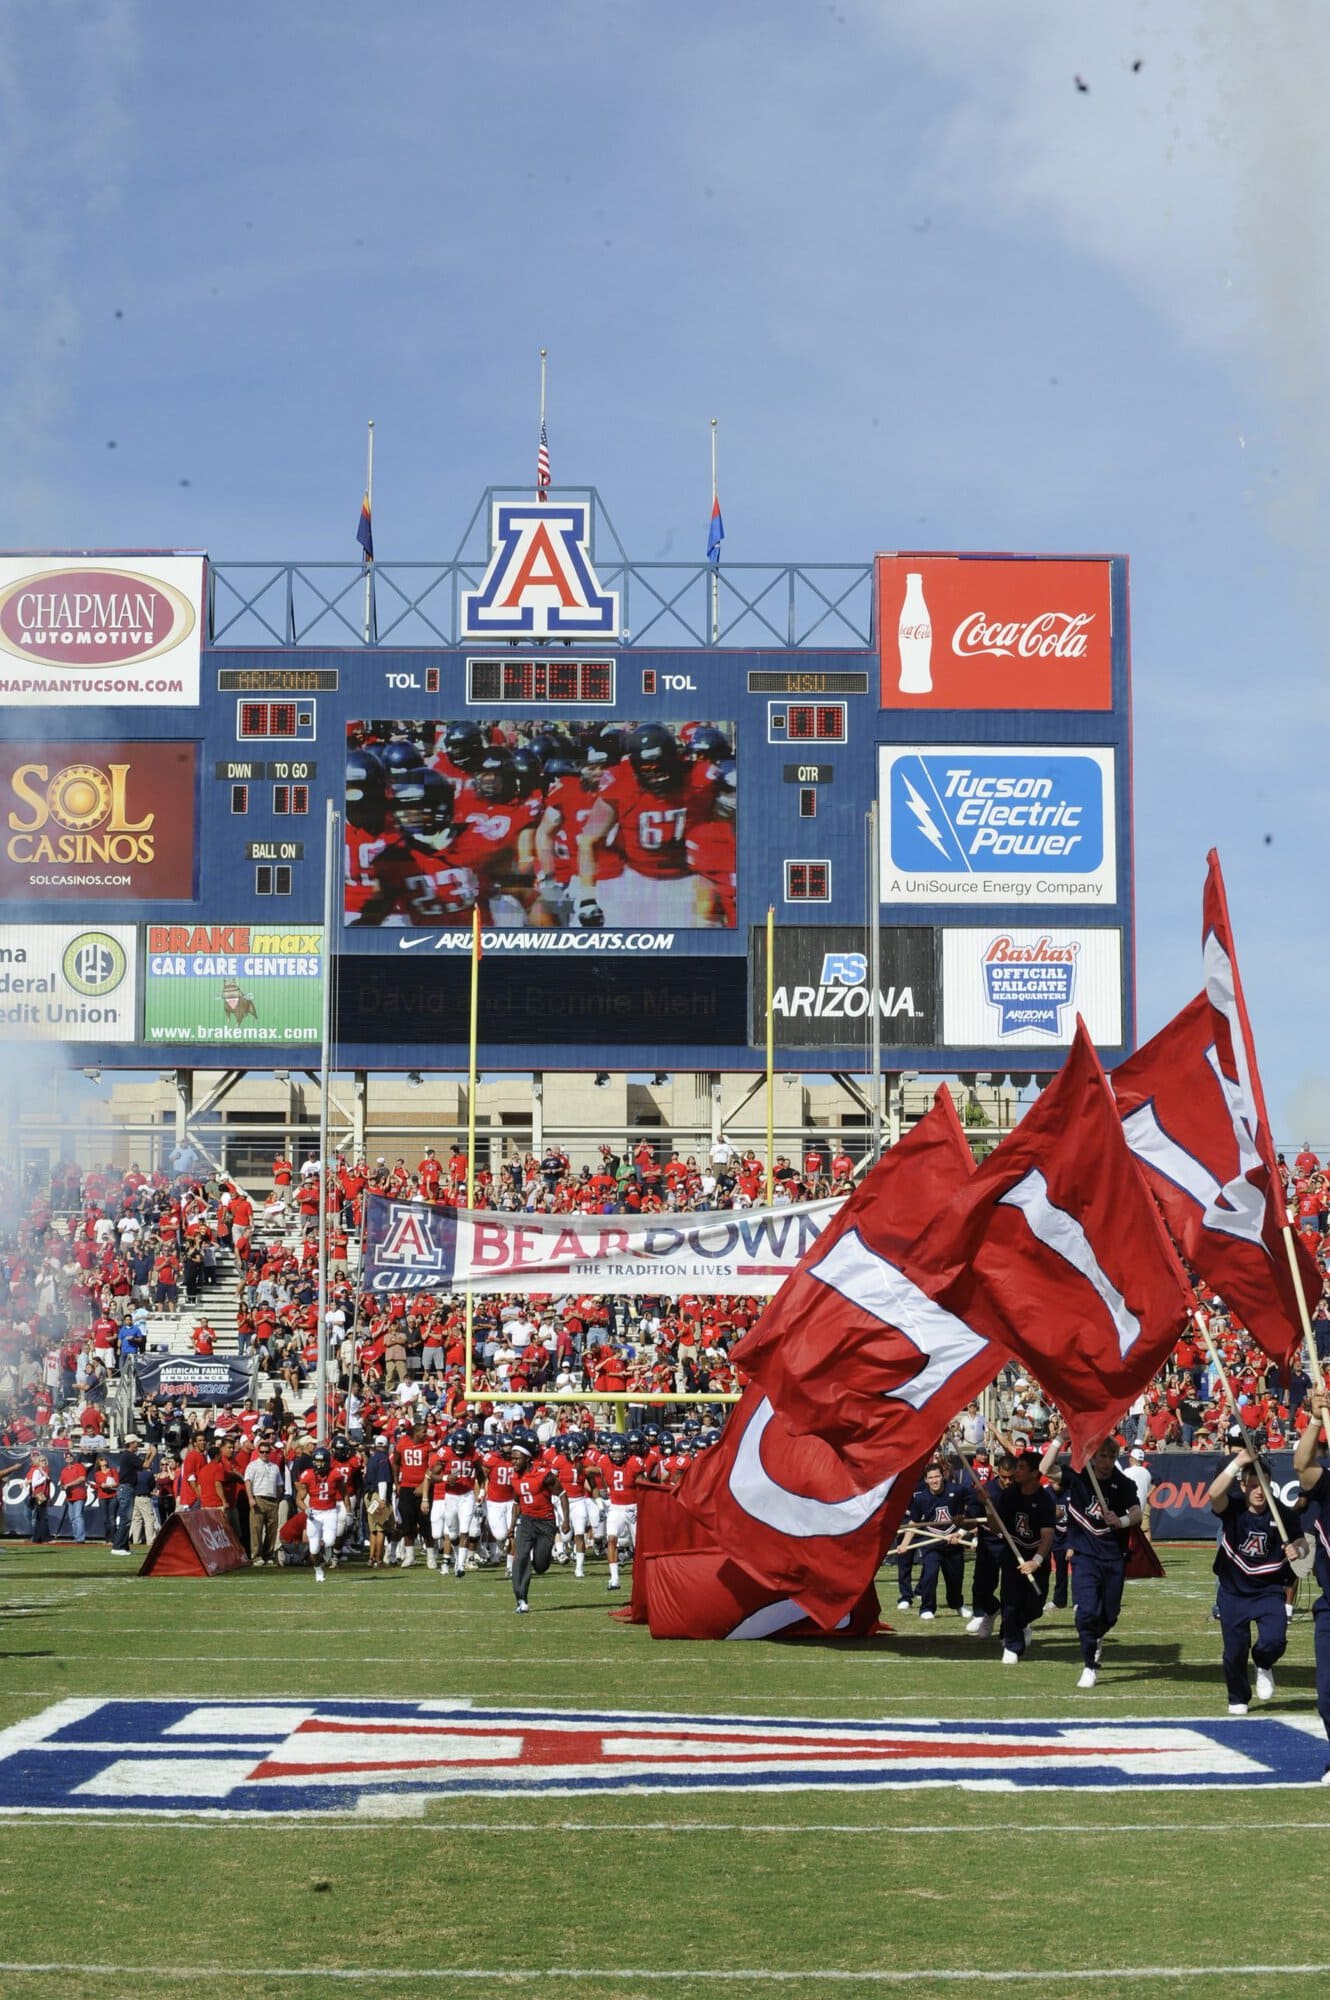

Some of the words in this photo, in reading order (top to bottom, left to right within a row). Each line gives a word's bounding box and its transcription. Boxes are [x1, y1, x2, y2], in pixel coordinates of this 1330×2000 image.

[461, 502, 619, 637] A
[16, 593, 156, 629] CHAPMAN
[20, 632, 153, 644] AUTOMOTIVE
[951, 611, 1096, 658] Coca-Cola
[239, 671, 318, 689] ARIZONA
[385, 673, 421, 689] TOL
[662, 675, 697, 690] TOL
[227, 763, 252, 778] DWN
[275, 763, 289, 778] TO
[292, 763, 308, 779] GO
[797, 766, 819, 781] QTR
[944, 770, 1053, 798] Tucson
[8, 764, 154, 832] SOL
[955, 799, 1082, 827] Electric
[639, 807, 688, 850] 67
[7, 835, 154, 864] CASINOS
[252, 844, 277, 858] BALL
[280, 844, 296, 858] ON
[968, 828, 1082, 855] Power
[29, 875, 131, 886] SOLCASINOS.COM
[890, 880, 901, 893] A
[905, 880, 978, 893] UniSource
[983, 880, 1032, 897] Energy
[1036, 880, 1103, 897] Company
[149, 927, 251, 954] BRAKE
[251, 934, 324, 955] max
[435, 933, 675, 950] ARIONAWILDCATS.COM
[151, 957, 186, 976] CAR
[193, 957, 237, 976] CARE
[244, 957, 319, 976] CENTERS
[819, 952, 869, 986] FS
[992, 968, 1067, 979] OFFICIAL
[992, 981, 1067, 991] TAILGATE
[764, 986, 915, 1018] ARIZONA
[47, 1003, 117, 1024] Union
[151, 1025, 318, 1040] www.brakemax.com
[374, 1204, 442, 1270] A
[469, 1220, 657, 1268] BEAR
[576, 1264, 601, 1276] THE
[608, 1264, 687, 1276] TRADITION
[693, 1264, 732, 1276] LIVES
[373, 1271, 441, 1289] CLUB
[160, 1367, 200, 1375] AMERICAN
[201, 1367, 230, 1375] FAMILY
[403, 1449, 423, 1467] 69
[612, 1470, 625, 1492] 2
[318, 1481, 329, 1501] 2
[519, 1482, 534, 1505] 5
[1239, 1531, 1269, 1557] A
